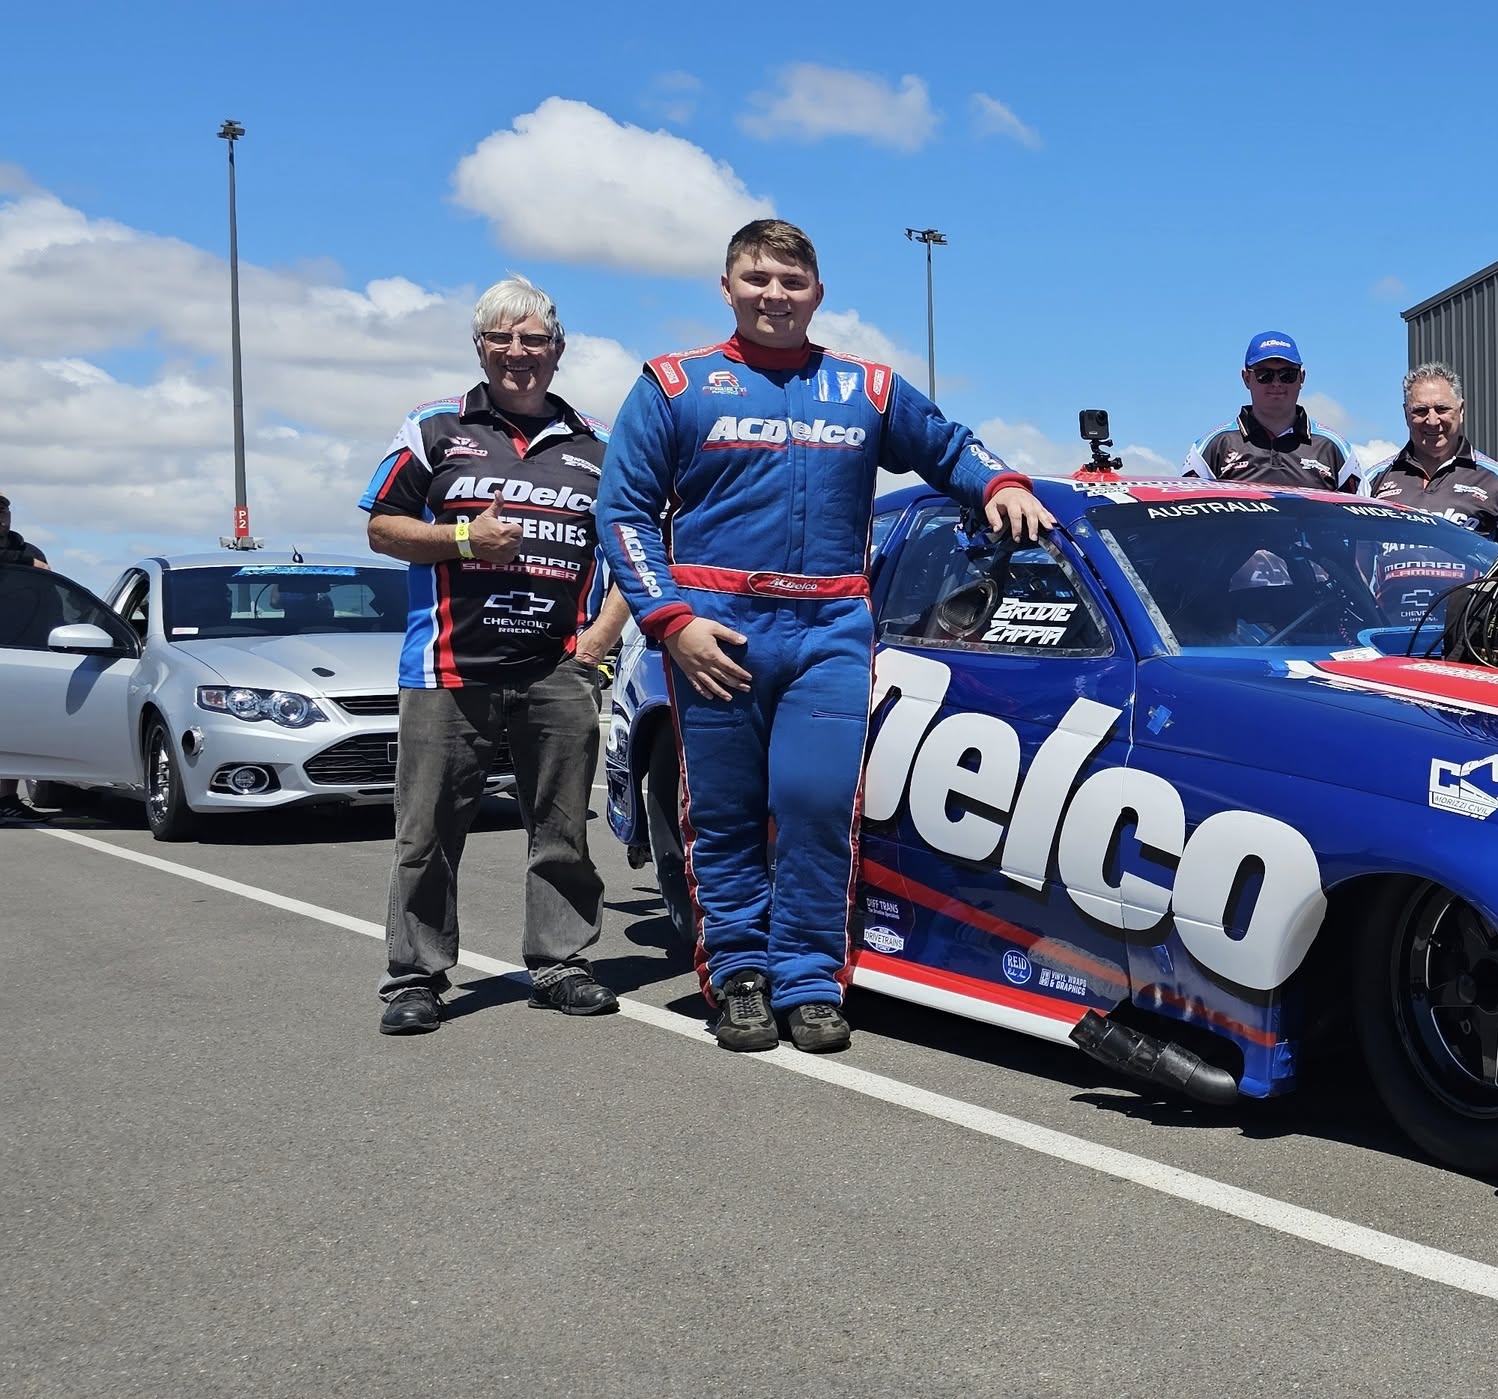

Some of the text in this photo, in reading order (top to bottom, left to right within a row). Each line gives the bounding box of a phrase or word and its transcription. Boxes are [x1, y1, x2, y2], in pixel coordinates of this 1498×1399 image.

[707, 416, 866, 446] ACDelco
[1147, 501, 1280, 520] AUSTRALIA
[1343, 505, 1402, 520] WIDE
[462, 562, 577, 581] SLAMMER
[619, 525, 664, 599] ACDelco
[1384, 561, 1466, 573] MONARO
[992, 597, 1079, 622] BRODIE
[981, 619, 1067, 645] ZAPPIA
[1434, 795, 1489, 816] MORIZZI CIVIL
[863, 647, 1328, 990] Delco
[878, 900, 899, 914] TRANS
[865, 930, 903, 948] DRIVETRAINS
[1007, 954, 1027, 970] REID
[1051, 970, 1066, 983] VINYL
[1067, 973, 1087, 987] WRAPS
[1055, 981, 1086, 996] GRAPHICS
